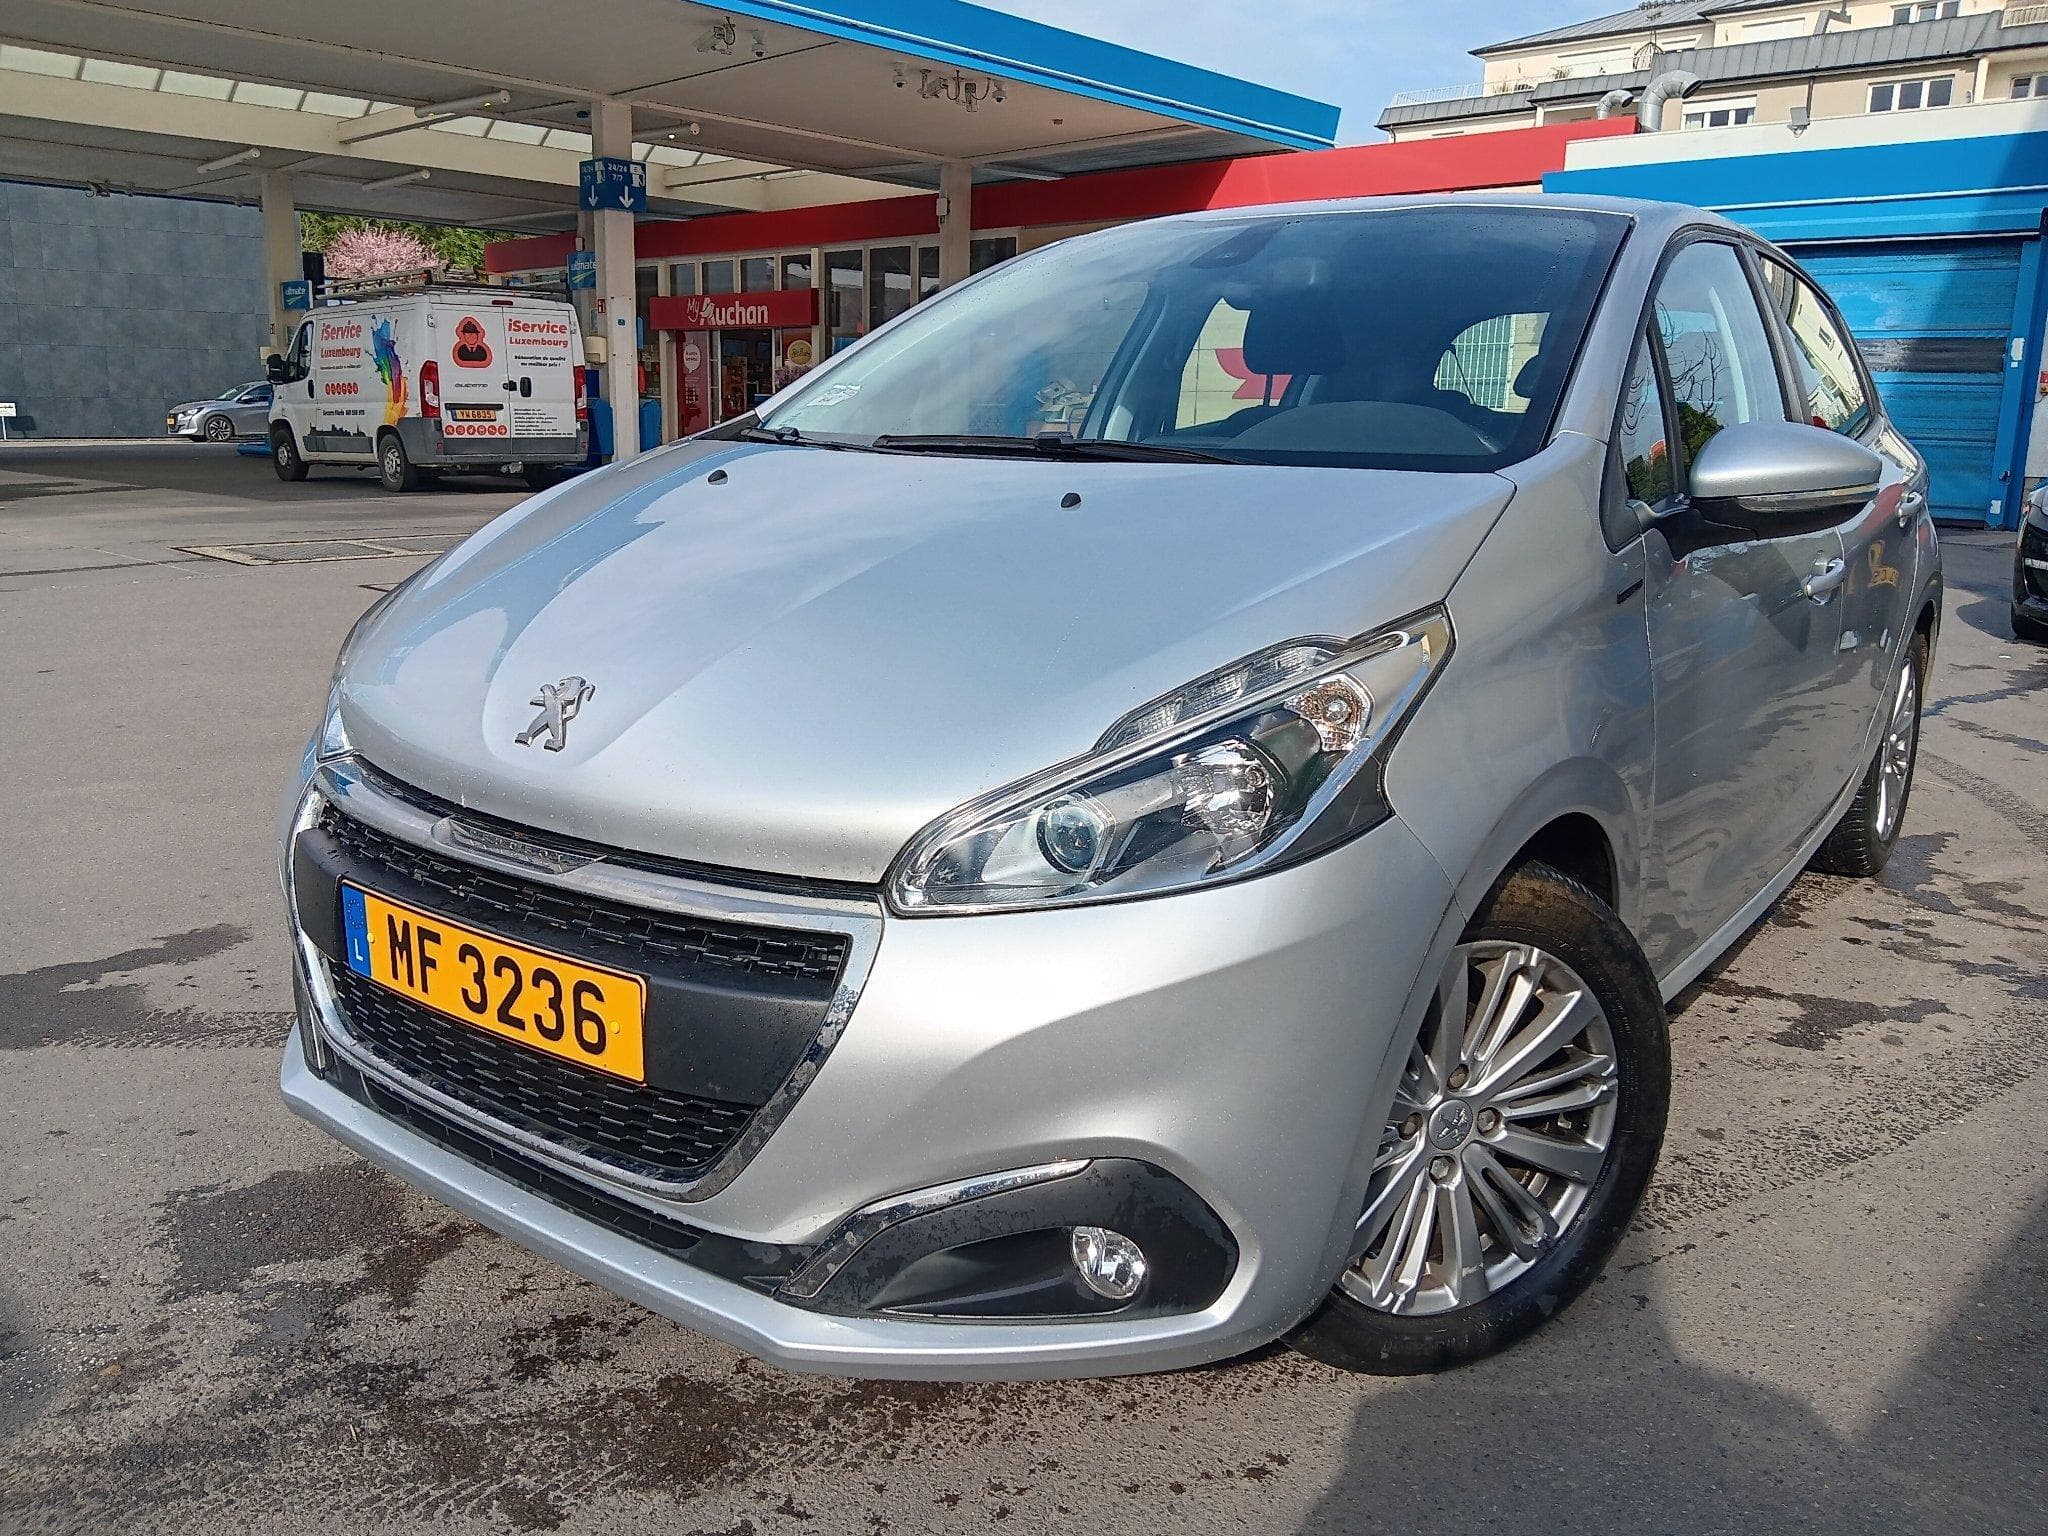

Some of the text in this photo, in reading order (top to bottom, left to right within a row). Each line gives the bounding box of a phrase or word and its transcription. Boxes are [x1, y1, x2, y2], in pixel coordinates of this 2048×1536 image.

[686, 297, 769, 326] My Auchan
[320, 320, 362, 341] iService
[508, 318, 568, 334] iService
[320, 346, 361, 359] Luxembourg
[509, 336, 569, 349] Luxembourg
[354, 938, 364, 962] L
[386, 913, 607, 1056] MF 3236
